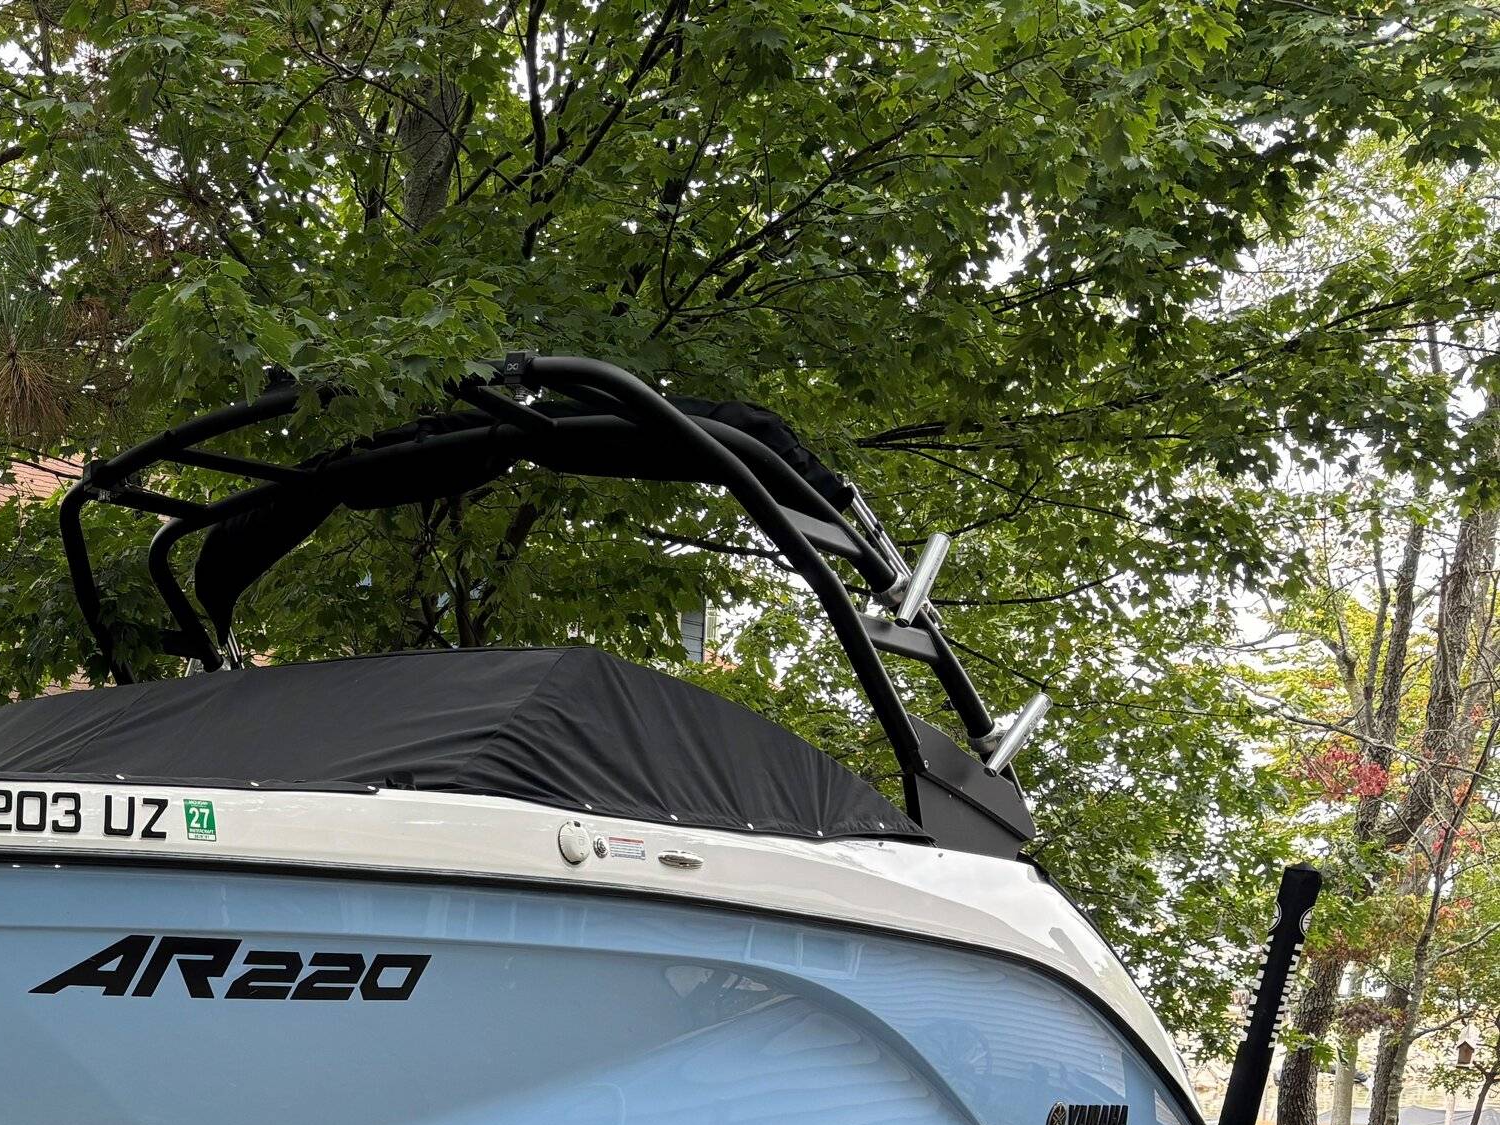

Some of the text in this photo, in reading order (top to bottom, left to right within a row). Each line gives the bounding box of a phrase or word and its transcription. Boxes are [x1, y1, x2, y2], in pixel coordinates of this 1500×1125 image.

[103, 795, 169, 839] UZ
[189, 807, 210, 829] 27
[28, 934, 432, 1001] AR220
